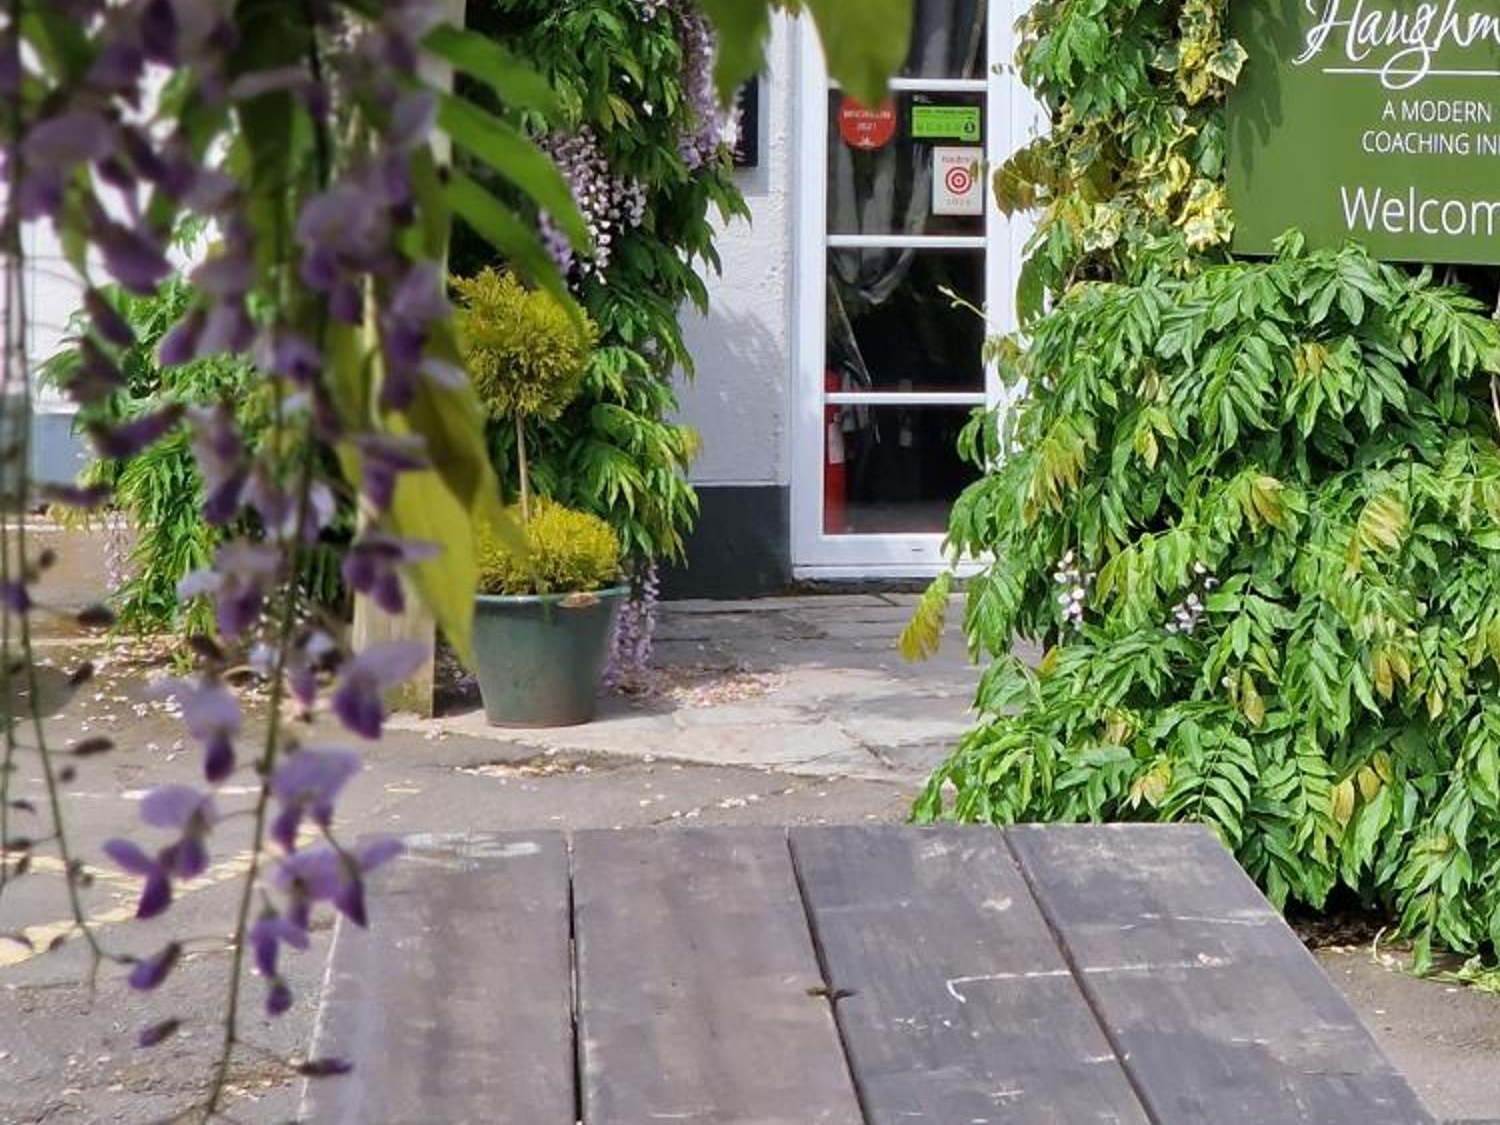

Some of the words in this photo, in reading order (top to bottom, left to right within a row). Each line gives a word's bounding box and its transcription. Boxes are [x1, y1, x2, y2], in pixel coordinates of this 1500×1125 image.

[1382, 100, 1396, 121] A
[1401, 100, 1492, 123] MODERN
[1362, 130, 1470, 155] COACHING
